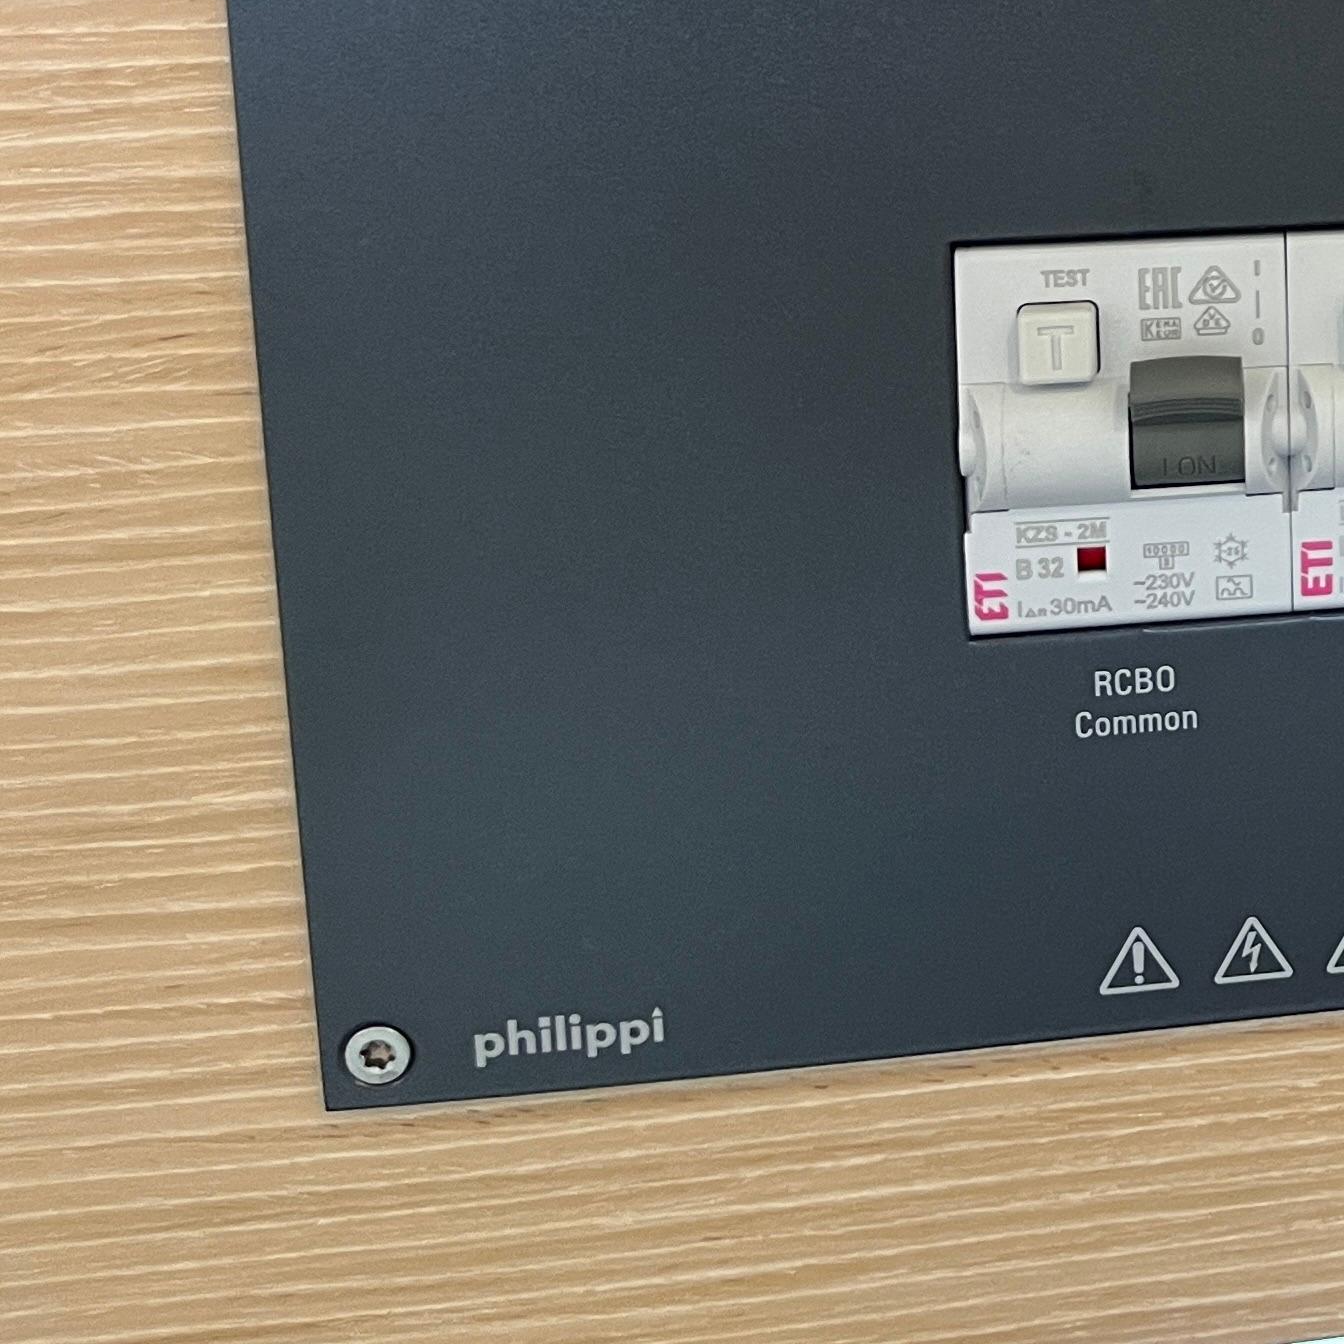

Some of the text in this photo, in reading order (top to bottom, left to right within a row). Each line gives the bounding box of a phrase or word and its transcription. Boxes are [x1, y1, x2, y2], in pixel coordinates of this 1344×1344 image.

[1039, 268, 1091, 289] TEST
[1077, 520, 1107, 540] 2M
[1016, 556, 1065, 580] B 32
[1300, 540, 1334, 597] ETI
[973, 572, 1009, 622] ETI
[1094, 665, 1175, 697] RCBO
[1075, 710, 1198, 739] Common
[473, 1006, 664, 1068] philippi
